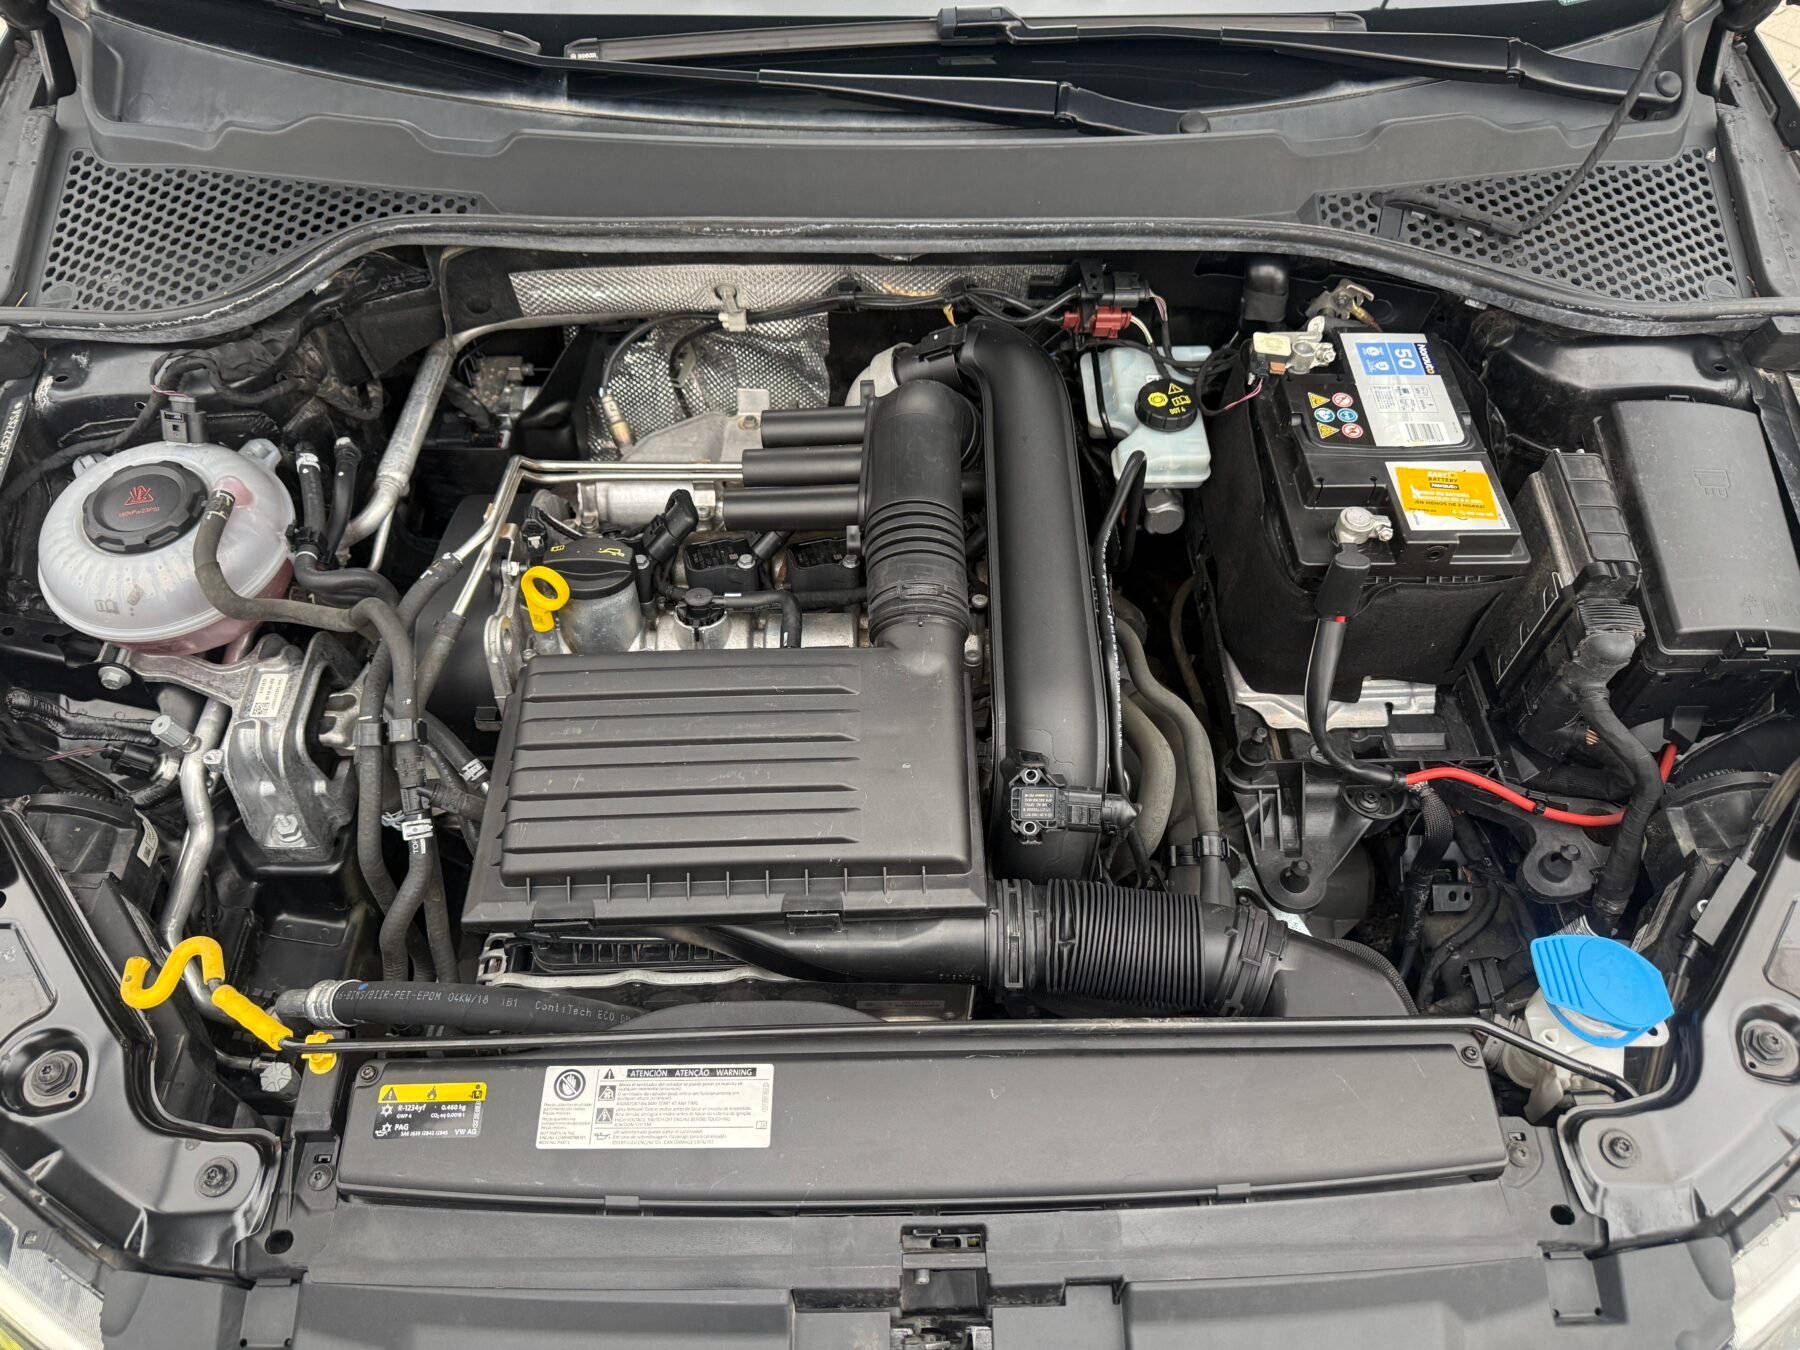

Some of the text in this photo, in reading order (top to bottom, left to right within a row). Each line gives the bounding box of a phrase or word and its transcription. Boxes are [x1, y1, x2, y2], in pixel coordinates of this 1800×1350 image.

[1394, 348, 1416, 369] 50
[1417, 343, 1436, 375] Norauto
[536, 1000, 592, 1017] ContiTech
[598, 1010, 614, 1022] ECO
[630, 1068, 667, 1077] ATENCIÓN
[674, 1068, 710, 1078] ATENÇÃO
[398, 1104, 426, 1113] R-1234yf
[459, 1104, 466, 1112] kg
